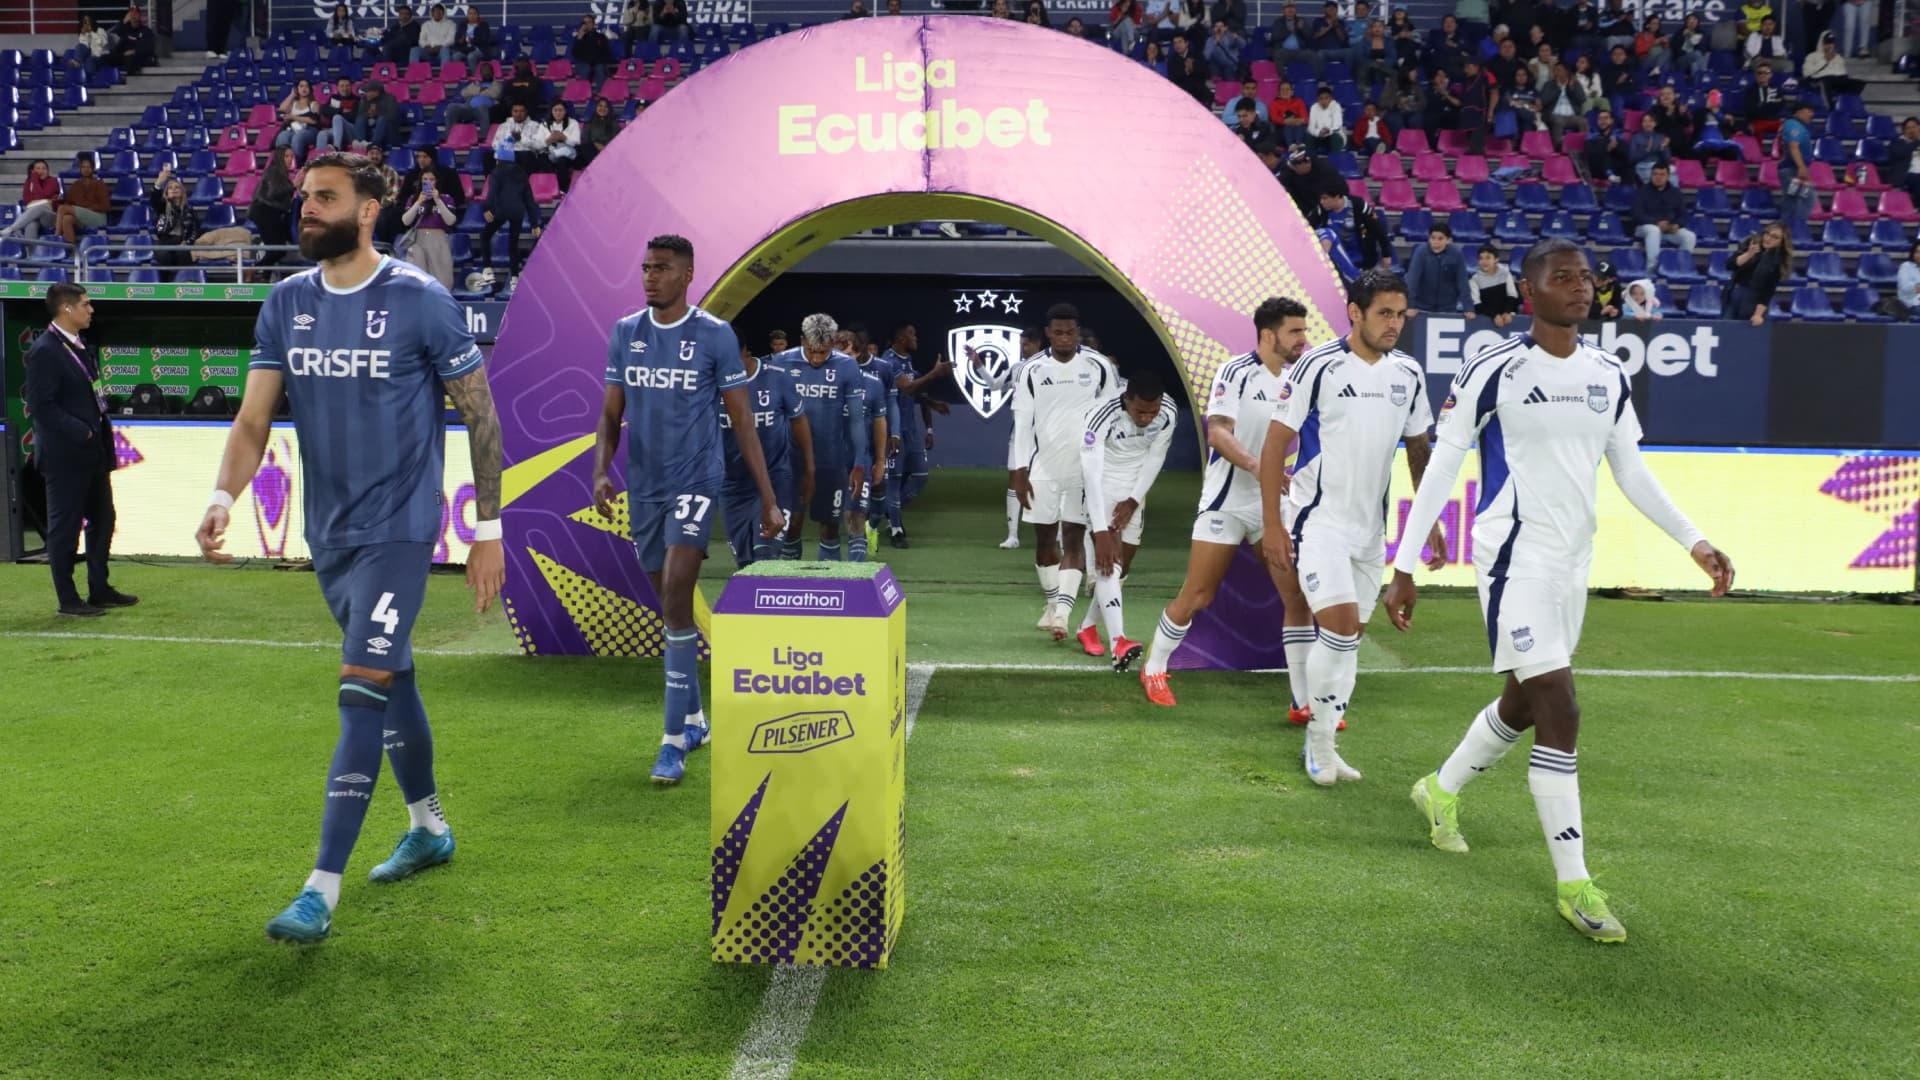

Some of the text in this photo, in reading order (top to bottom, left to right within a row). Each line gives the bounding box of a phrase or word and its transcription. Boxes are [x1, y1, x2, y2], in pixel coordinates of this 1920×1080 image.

[855, 52, 956, 101] Liga
[778, 98, 1053, 155] Ecuabet
[675, 494, 711, 522] 37
[833, 489, 843, 508] 8
[371, 592, 399, 634] 4
[759, 593, 840, 608] marathon
[774, 646, 823, 671] Liga
[733, 669, 866, 696] Ecuabet
[763, 717, 839, 748] PILSENER
